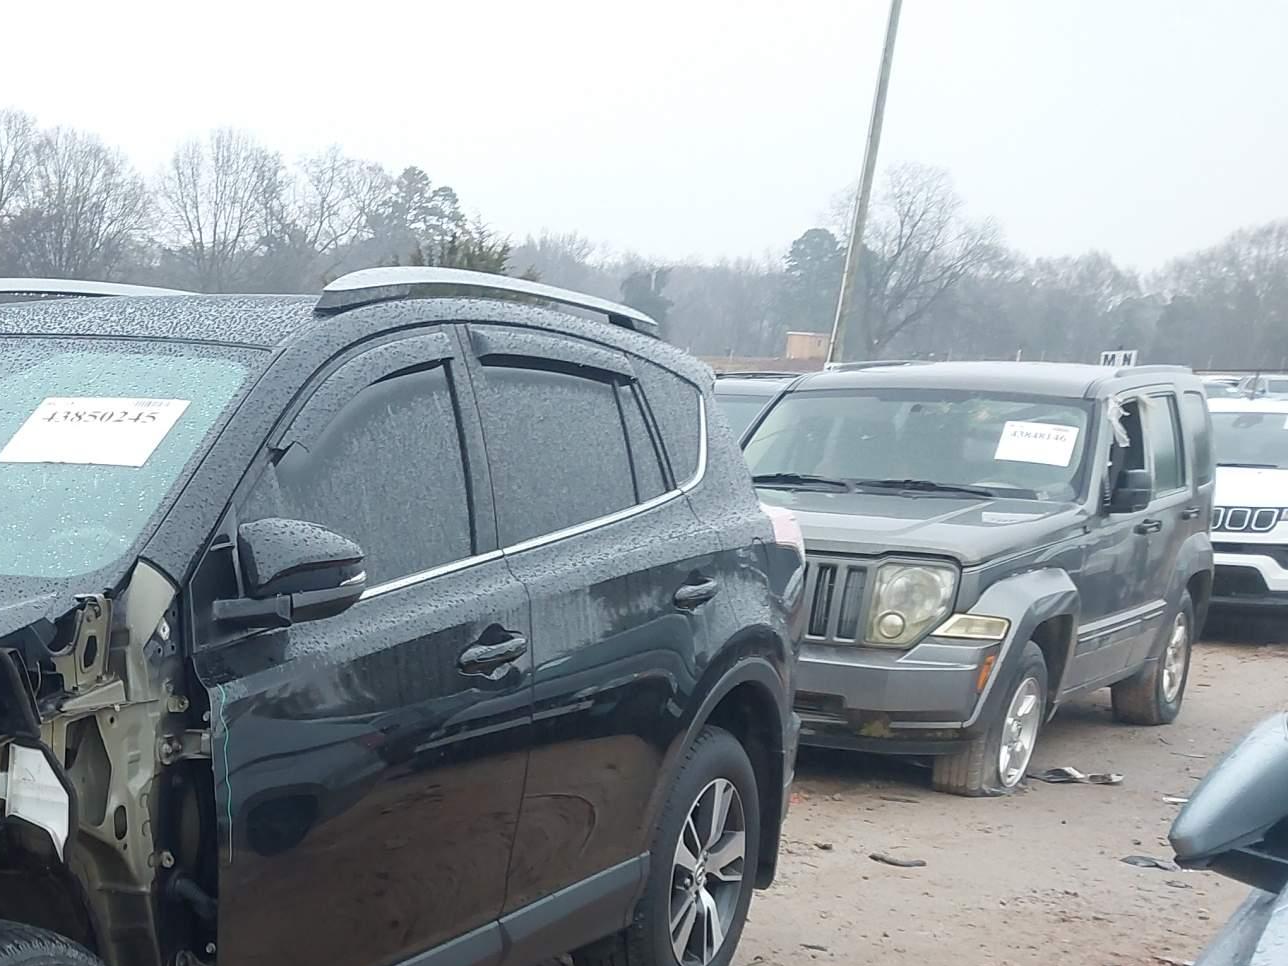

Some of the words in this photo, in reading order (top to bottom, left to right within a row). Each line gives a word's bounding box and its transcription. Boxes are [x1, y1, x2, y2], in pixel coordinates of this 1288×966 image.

[1102, 353, 1116, 367] M
[1121, 352, 1133, 367] N
[42, 410, 160, 424] 43850245
